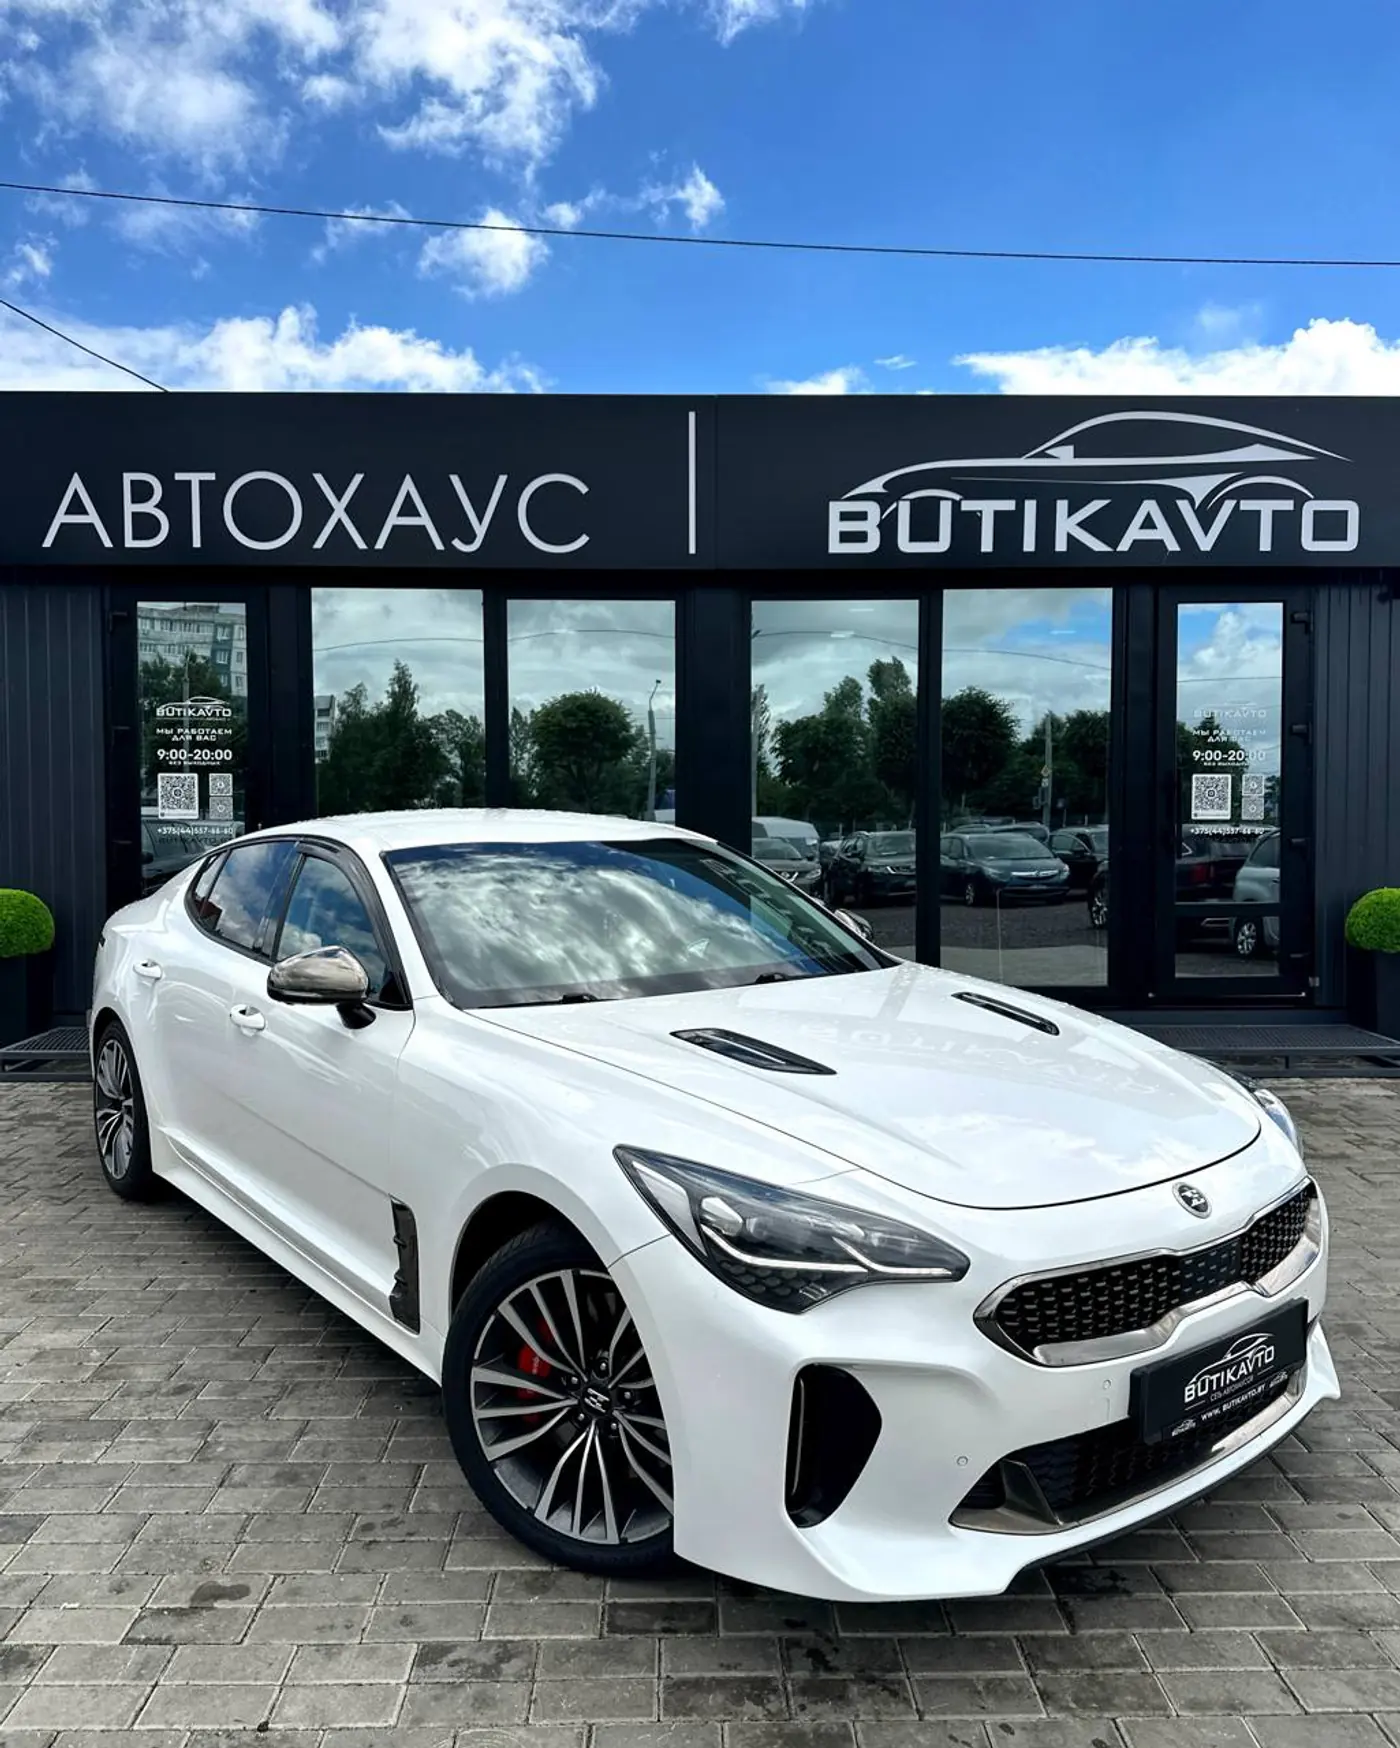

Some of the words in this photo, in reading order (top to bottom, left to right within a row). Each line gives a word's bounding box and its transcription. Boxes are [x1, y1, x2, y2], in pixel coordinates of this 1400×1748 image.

[42, 471, 590, 553] АВТОХАУС
[828, 499, 1359, 553] BUTIKAVTO
[156, 707, 232, 717] BUTIKAVTO
[157, 749, 233, 761] 9:00-20:00
[1192, 749, 1266, 761] 9:00-20:00
[1184, 1345, 1275, 1403] BUTIKAVTO
